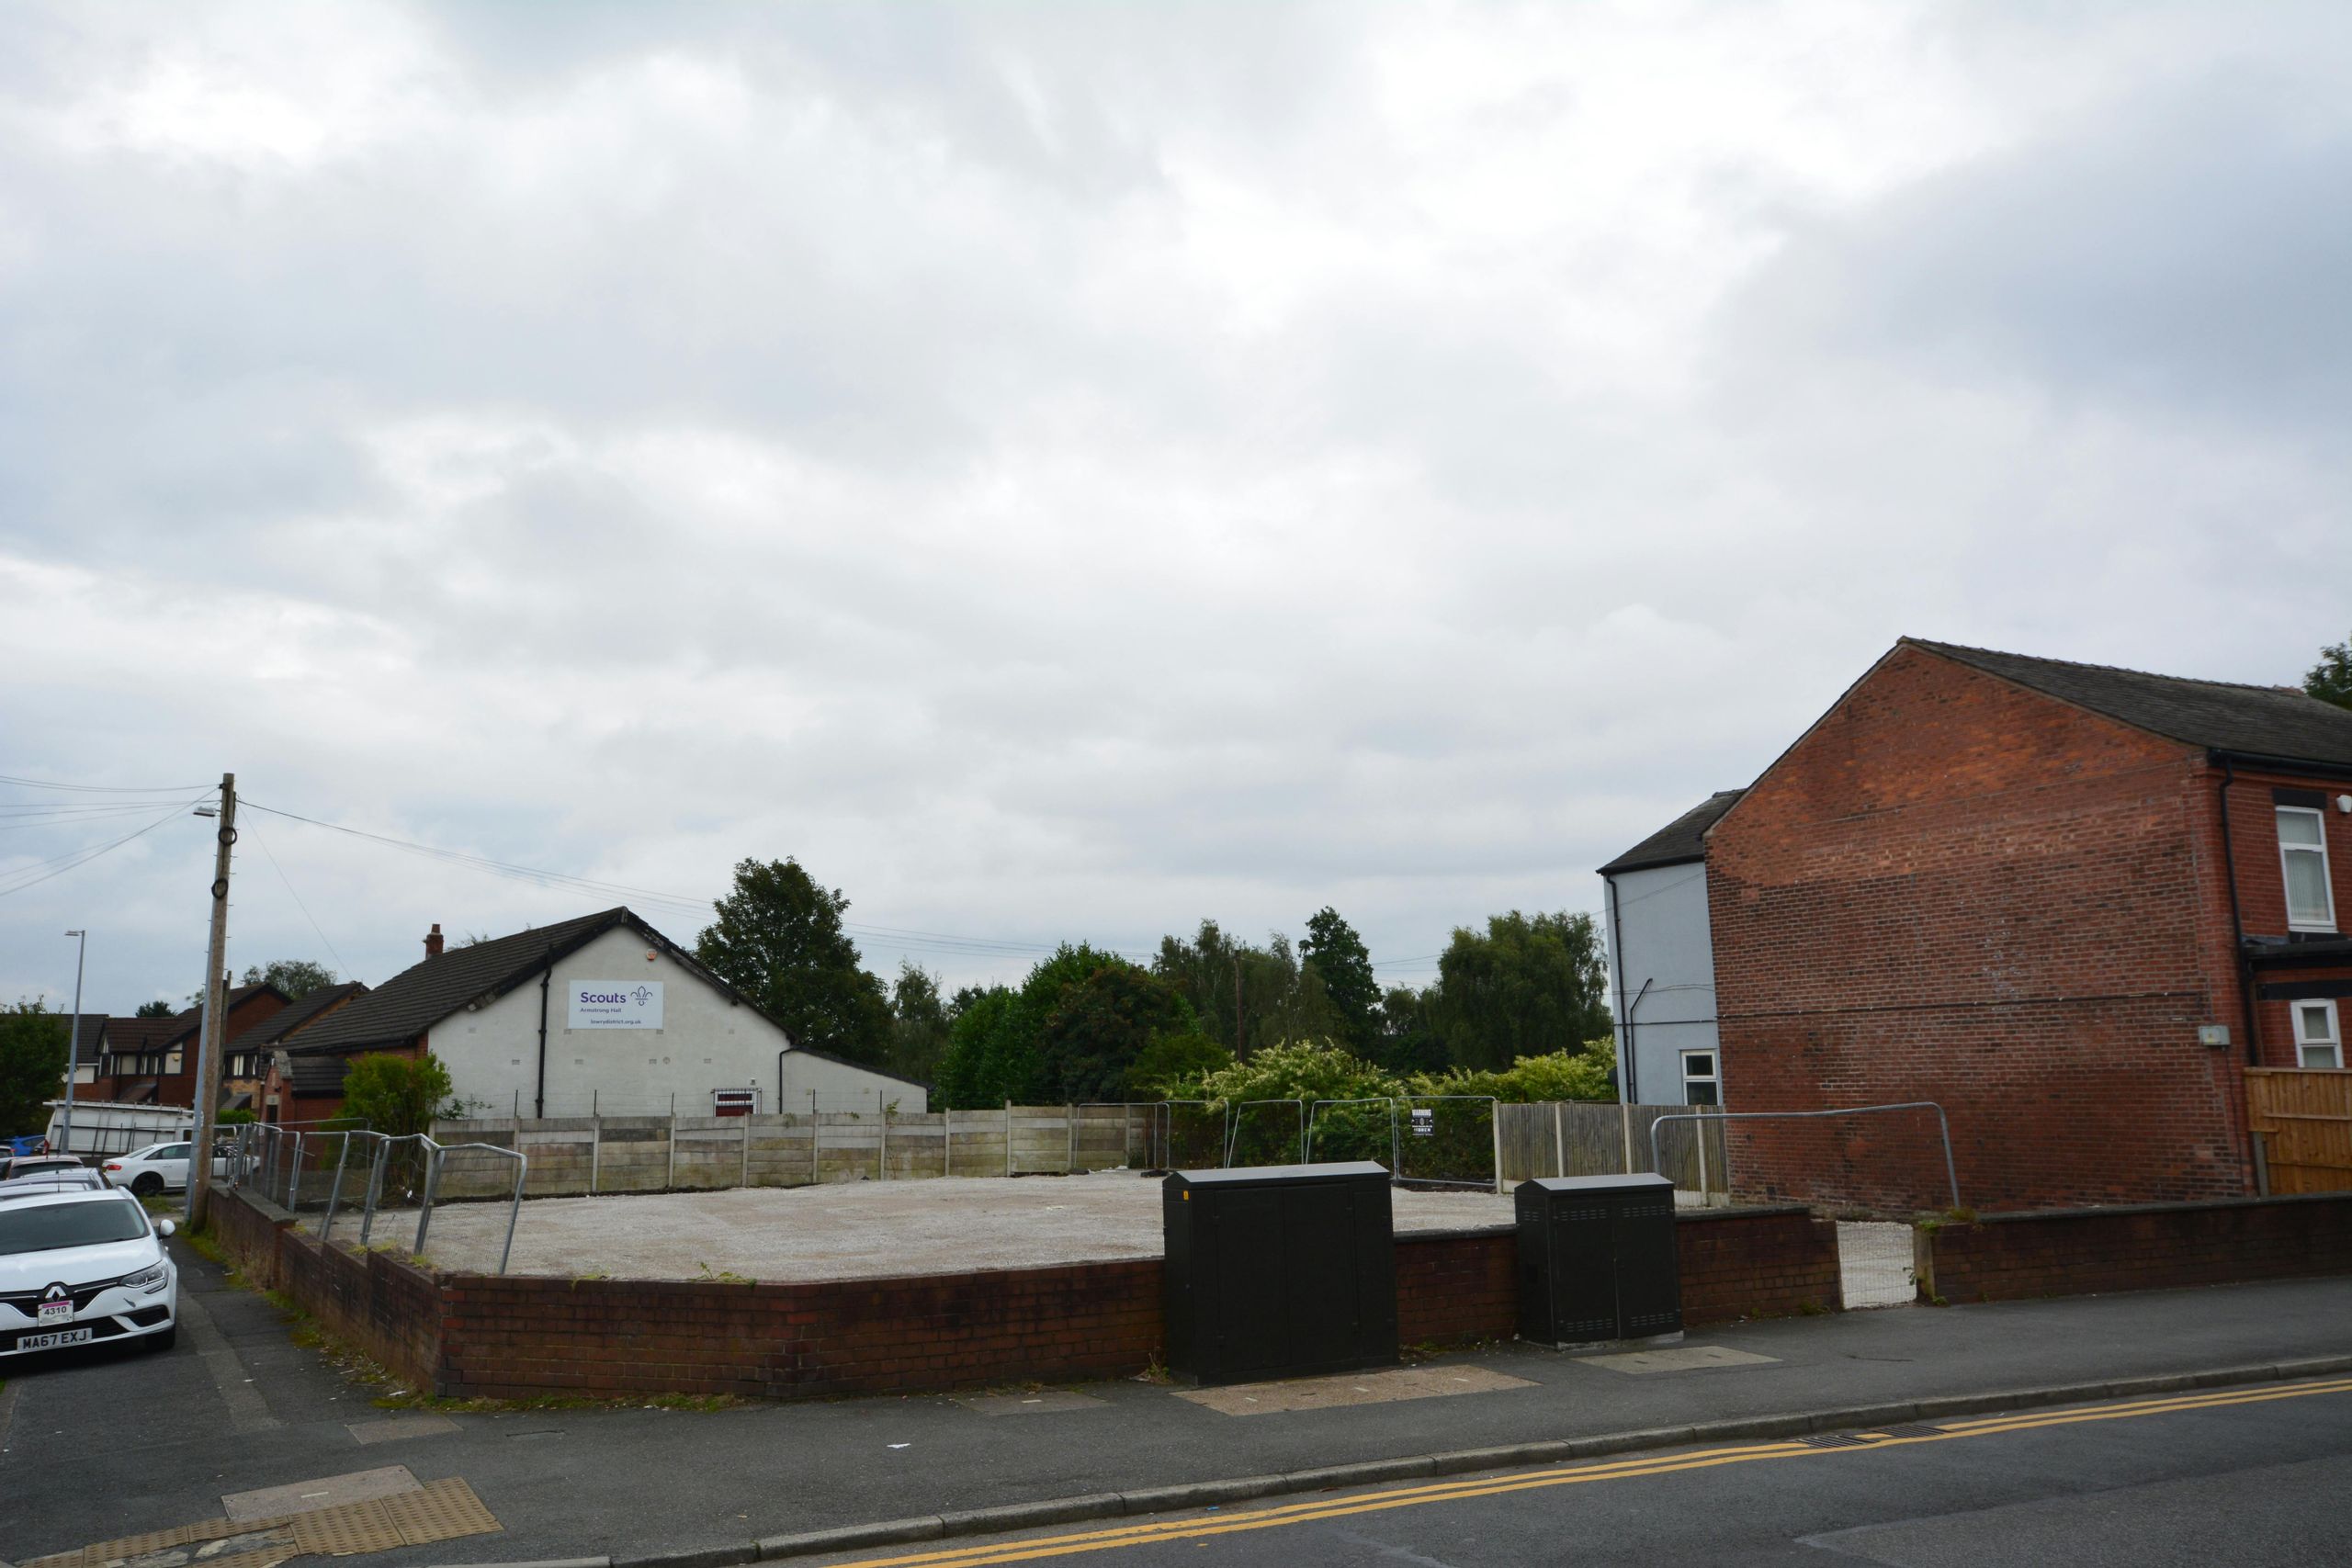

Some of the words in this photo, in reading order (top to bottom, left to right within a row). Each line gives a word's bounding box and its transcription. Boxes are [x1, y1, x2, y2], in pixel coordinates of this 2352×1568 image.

[581, 992, 627, 1003] Scouts
[44, 1306, 67, 1315] 4310
[23, 1334, 58, 1349] MA67
[62, 1330, 86, 1344] EXJ
